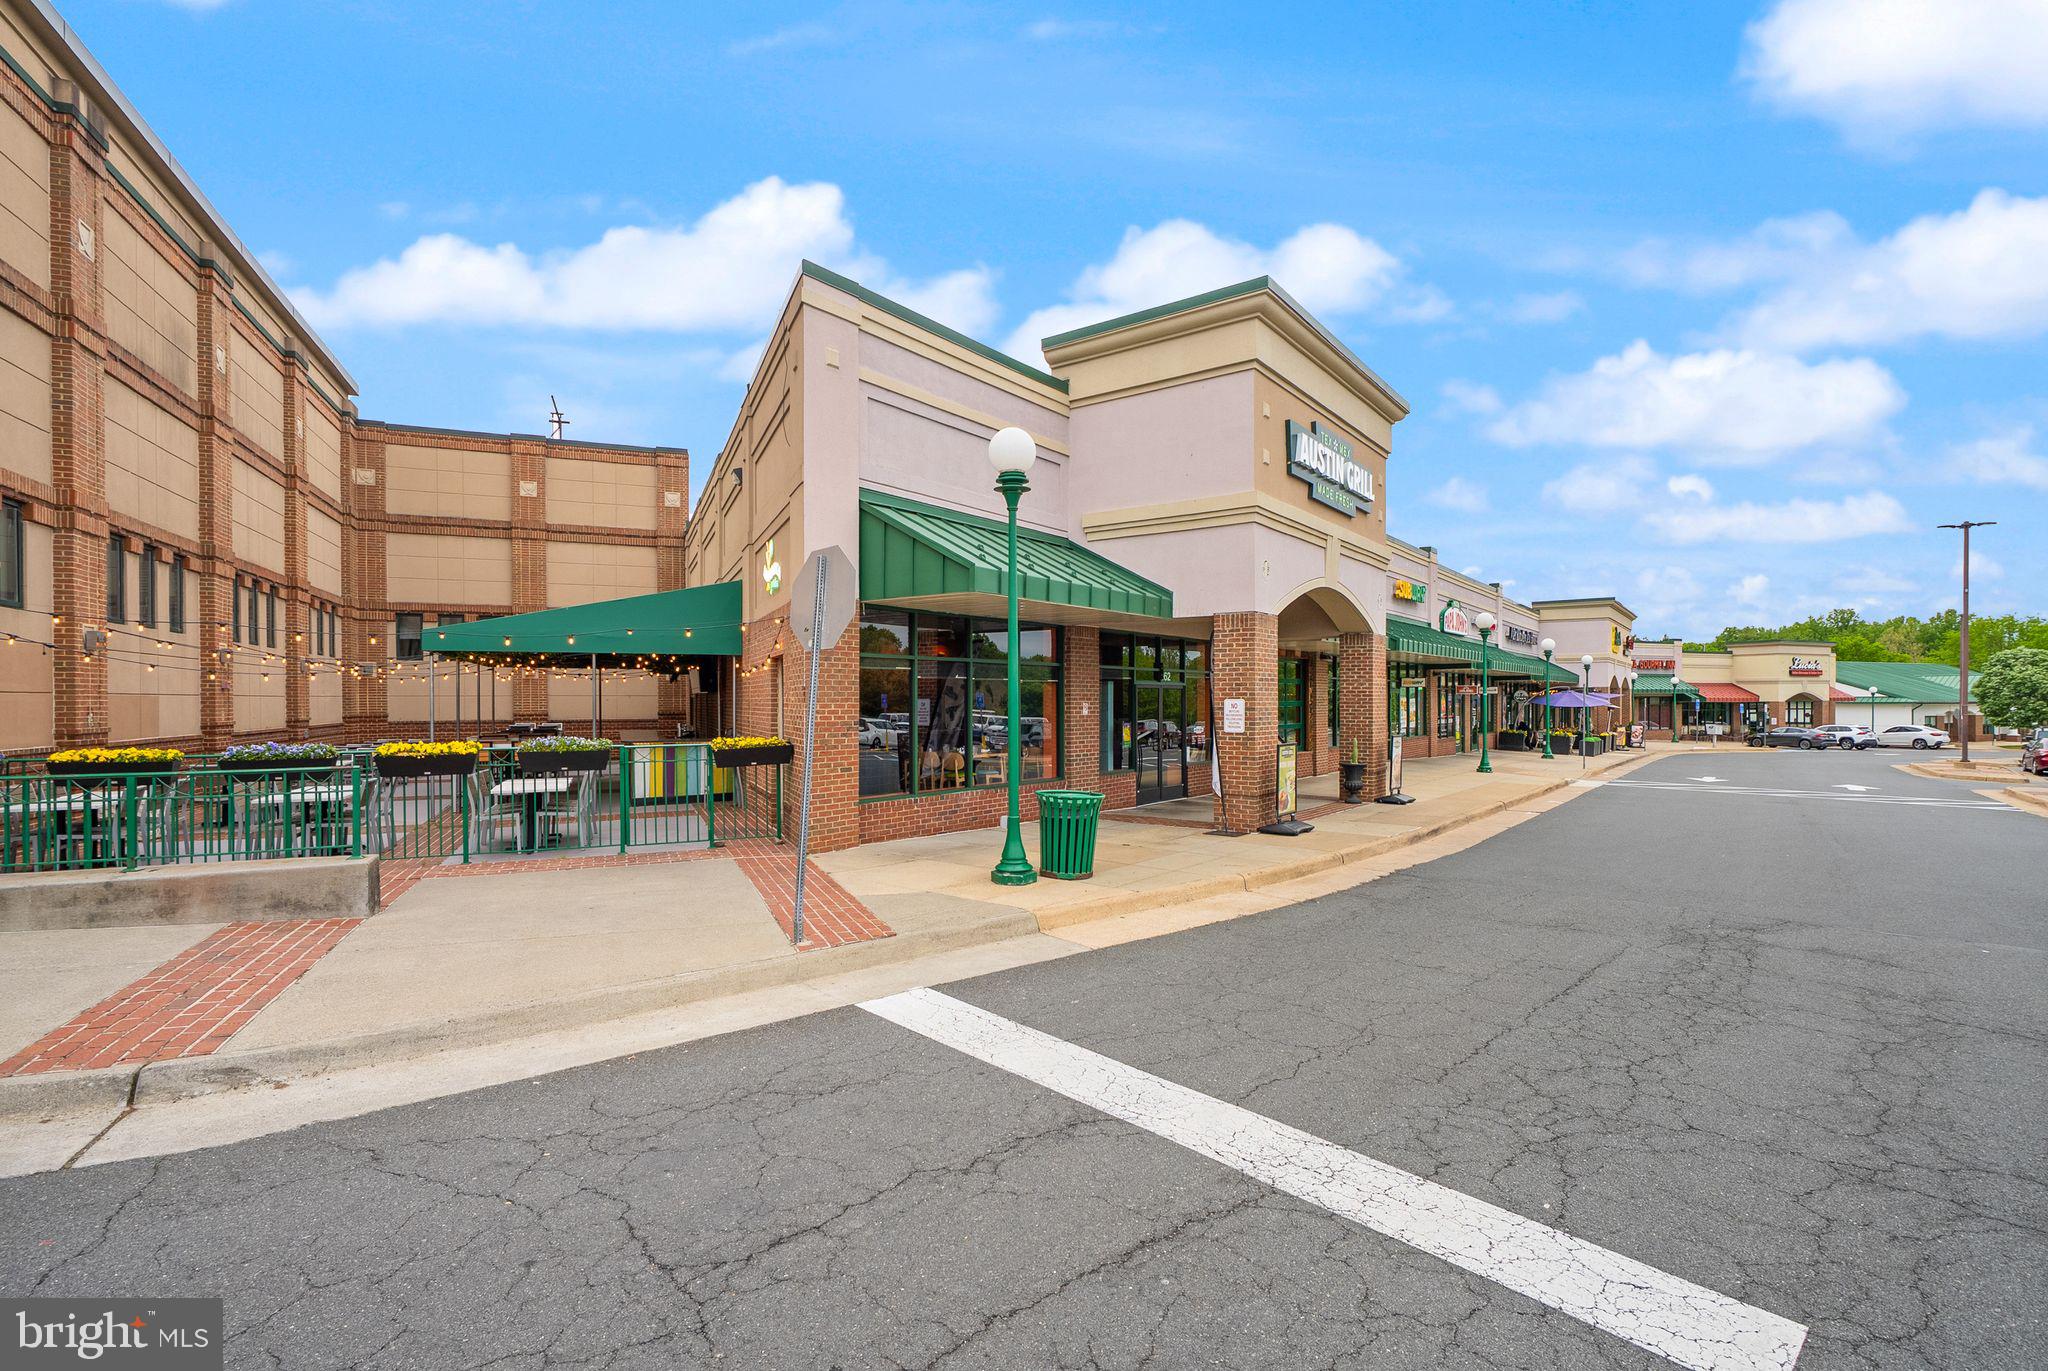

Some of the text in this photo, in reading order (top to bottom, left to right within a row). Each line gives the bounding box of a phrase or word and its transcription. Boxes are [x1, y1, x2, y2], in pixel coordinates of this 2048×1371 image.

[1321, 432, 1351, 460] TEX MEX
[1296, 432, 1373, 500] AUSTIN GRILL
[1317, 482, 1354, 510] MADE FRESH
[1231, 702, 1239, 710] NO
